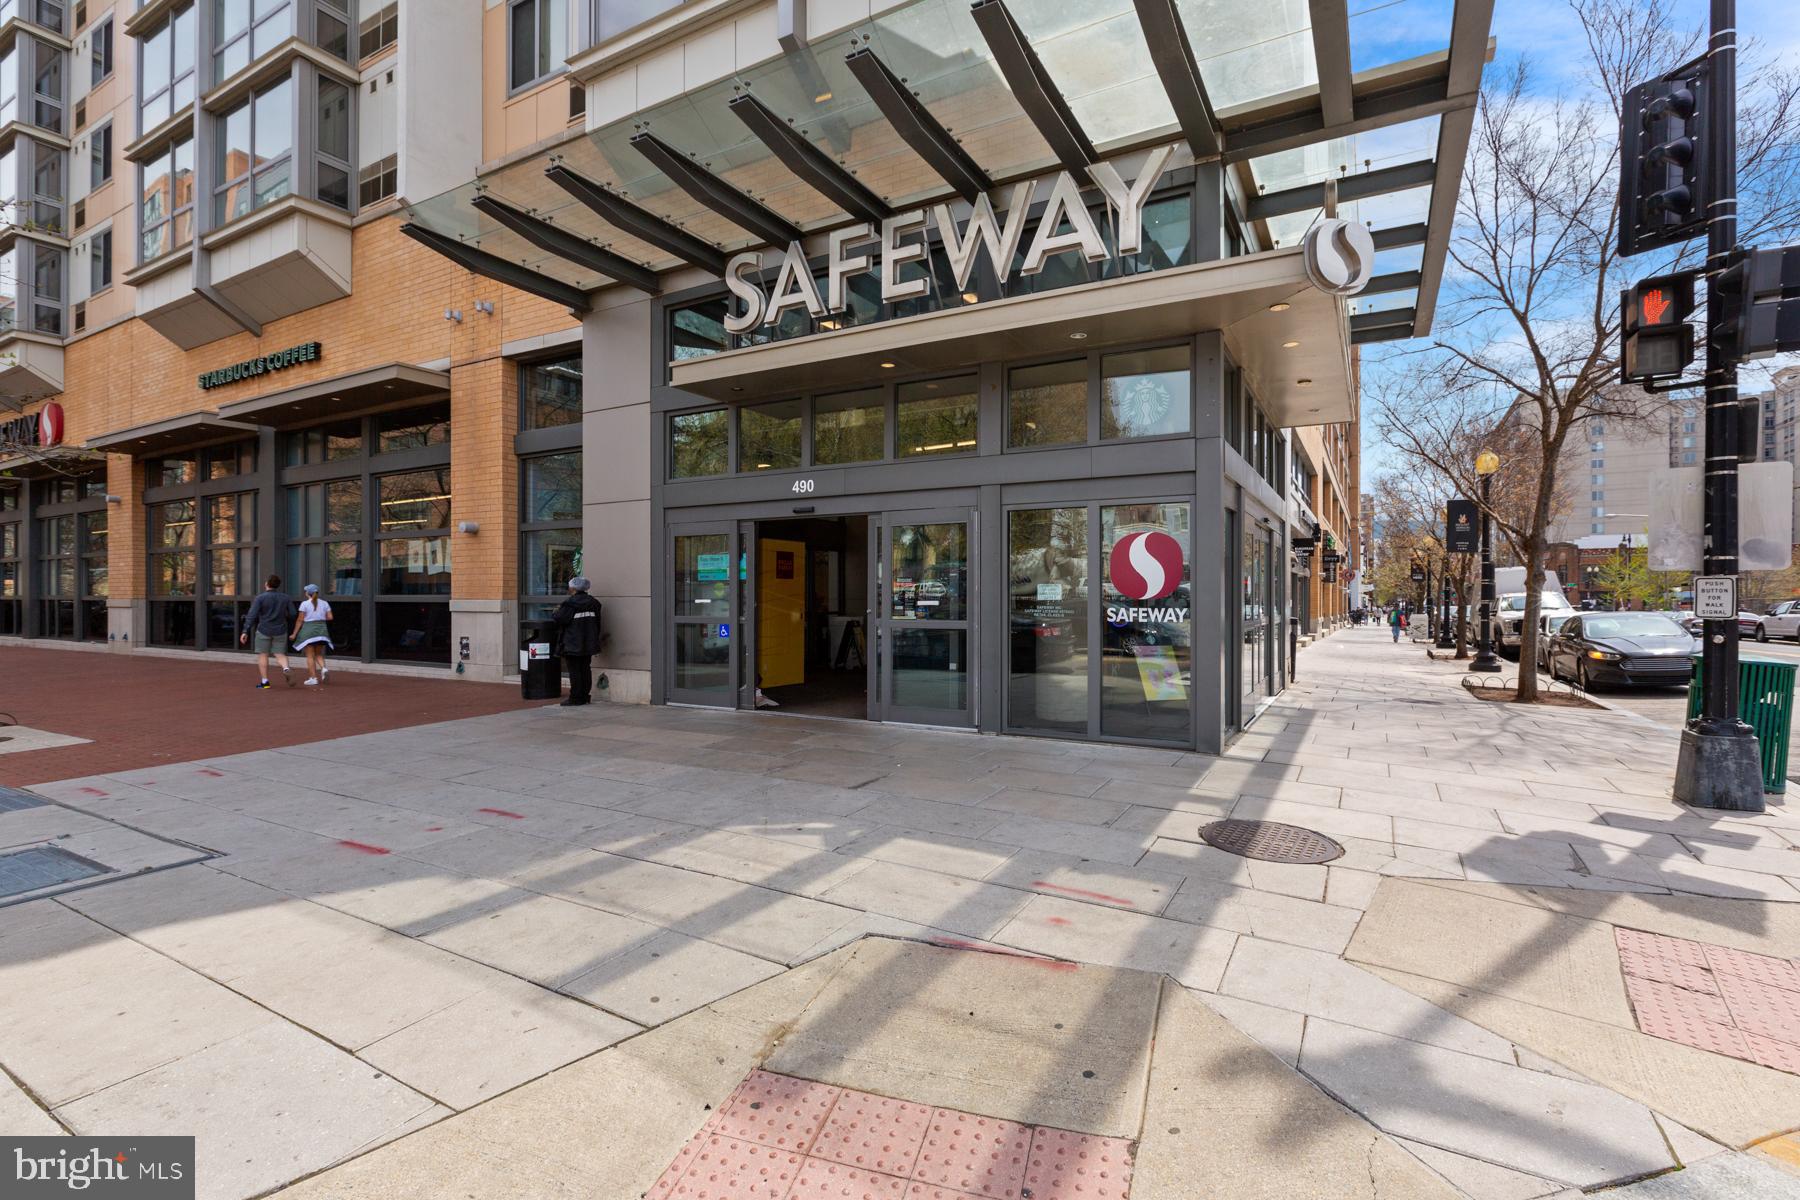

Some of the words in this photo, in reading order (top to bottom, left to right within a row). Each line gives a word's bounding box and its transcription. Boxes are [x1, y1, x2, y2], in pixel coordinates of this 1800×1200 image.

[723, 143, 1178, 335] SAFEWAY
[198, 357, 265, 388] STARBUCKS
[266, 342, 319, 371] COFFEE
[792, 479, 815, 493] 490
[1106, 607, 1188, 623] SAFEWAY
